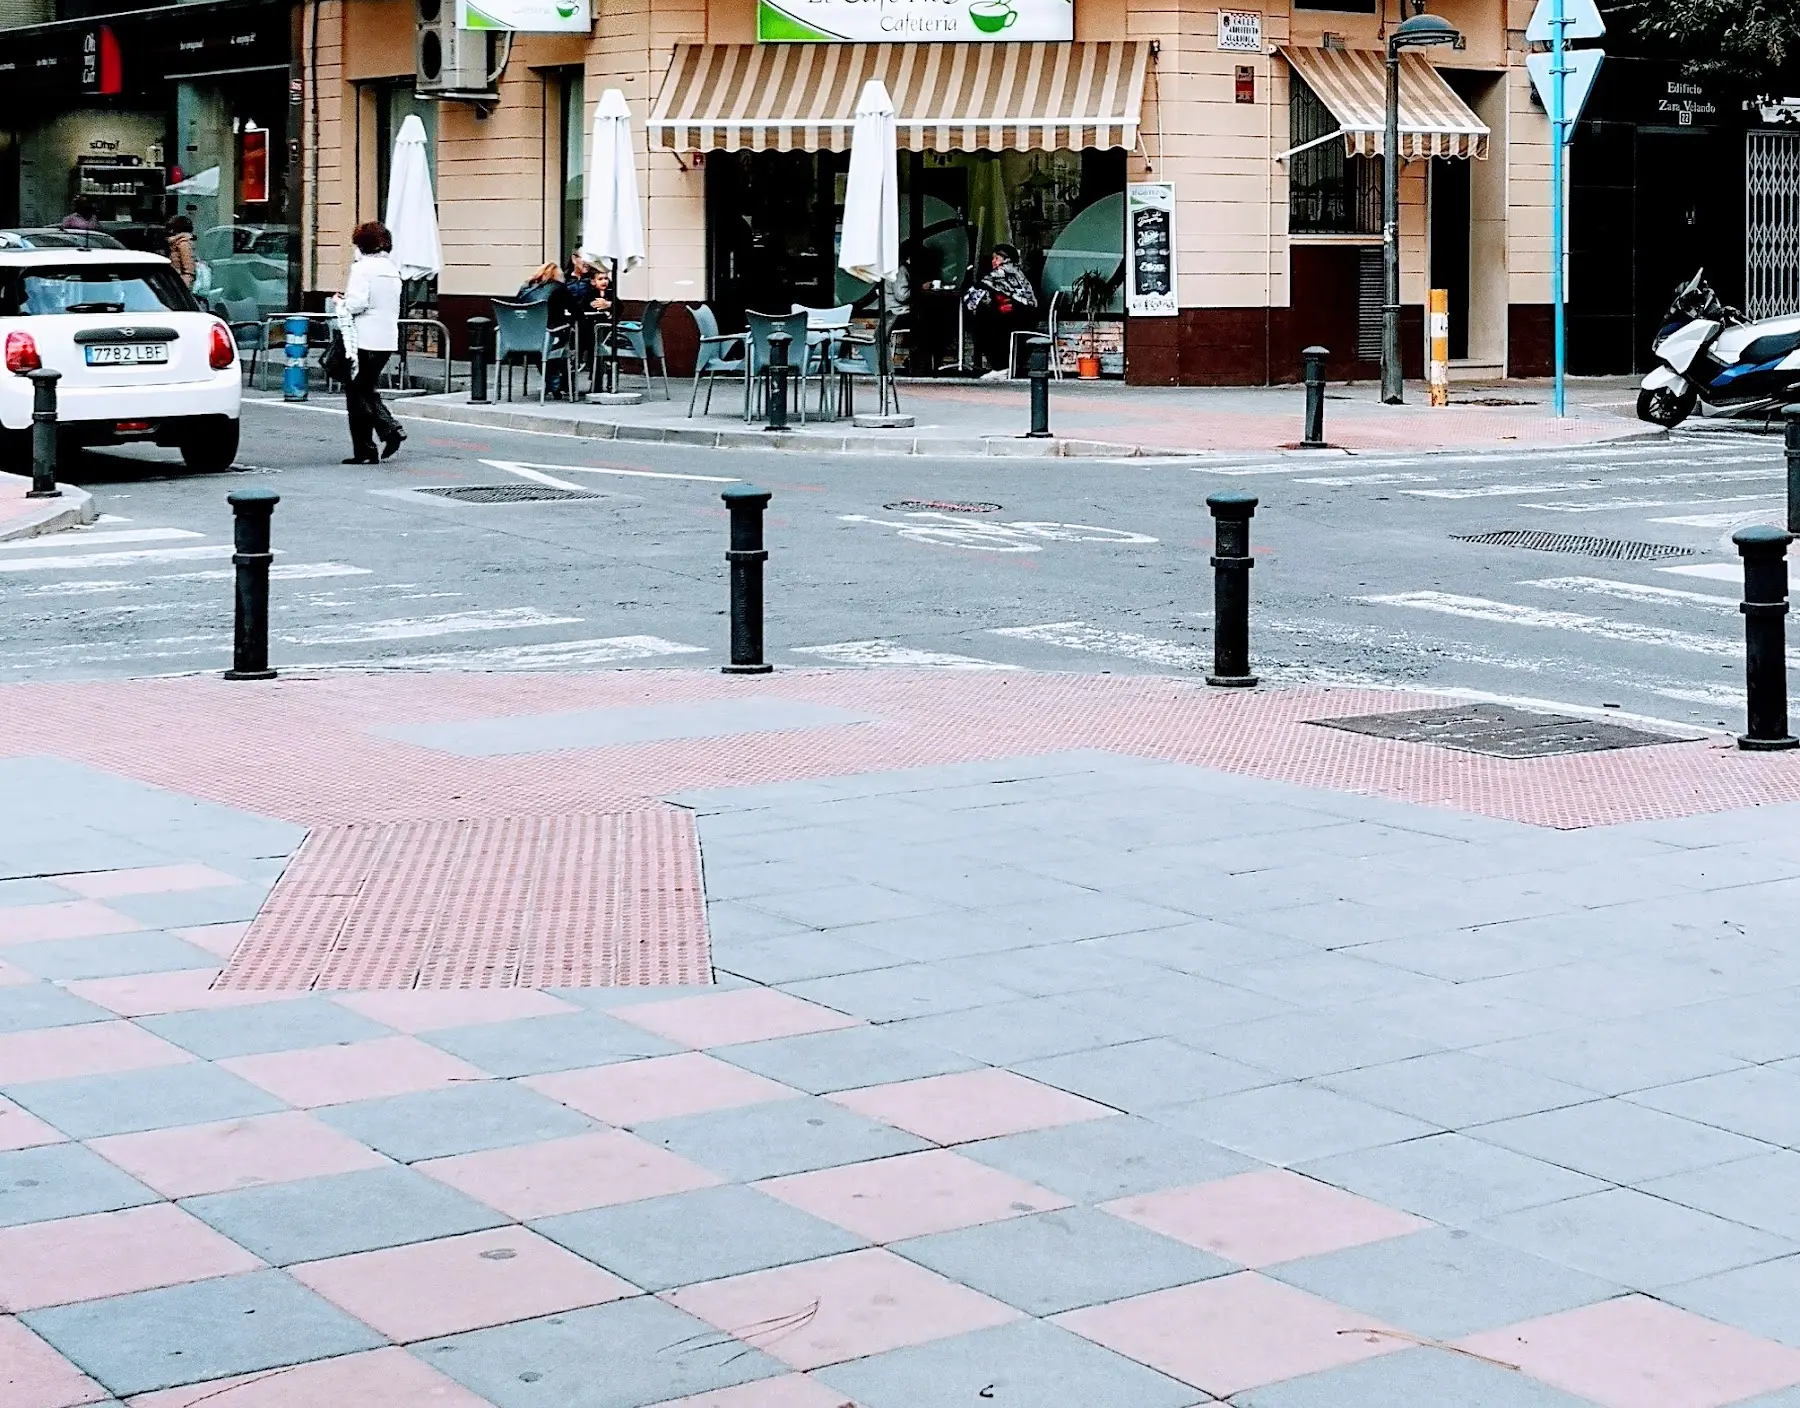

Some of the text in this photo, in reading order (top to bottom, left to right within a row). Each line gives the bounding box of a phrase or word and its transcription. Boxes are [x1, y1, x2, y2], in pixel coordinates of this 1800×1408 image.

[1233, 18, 1256, 26] CALLE
[1667, 81, 1703, 94] Edificio
[1658, 99, 1716, 113] Zara Velando
[1681, 113, 1689, 123] 22
[94, 346, 163, 361] 7782 LBF
